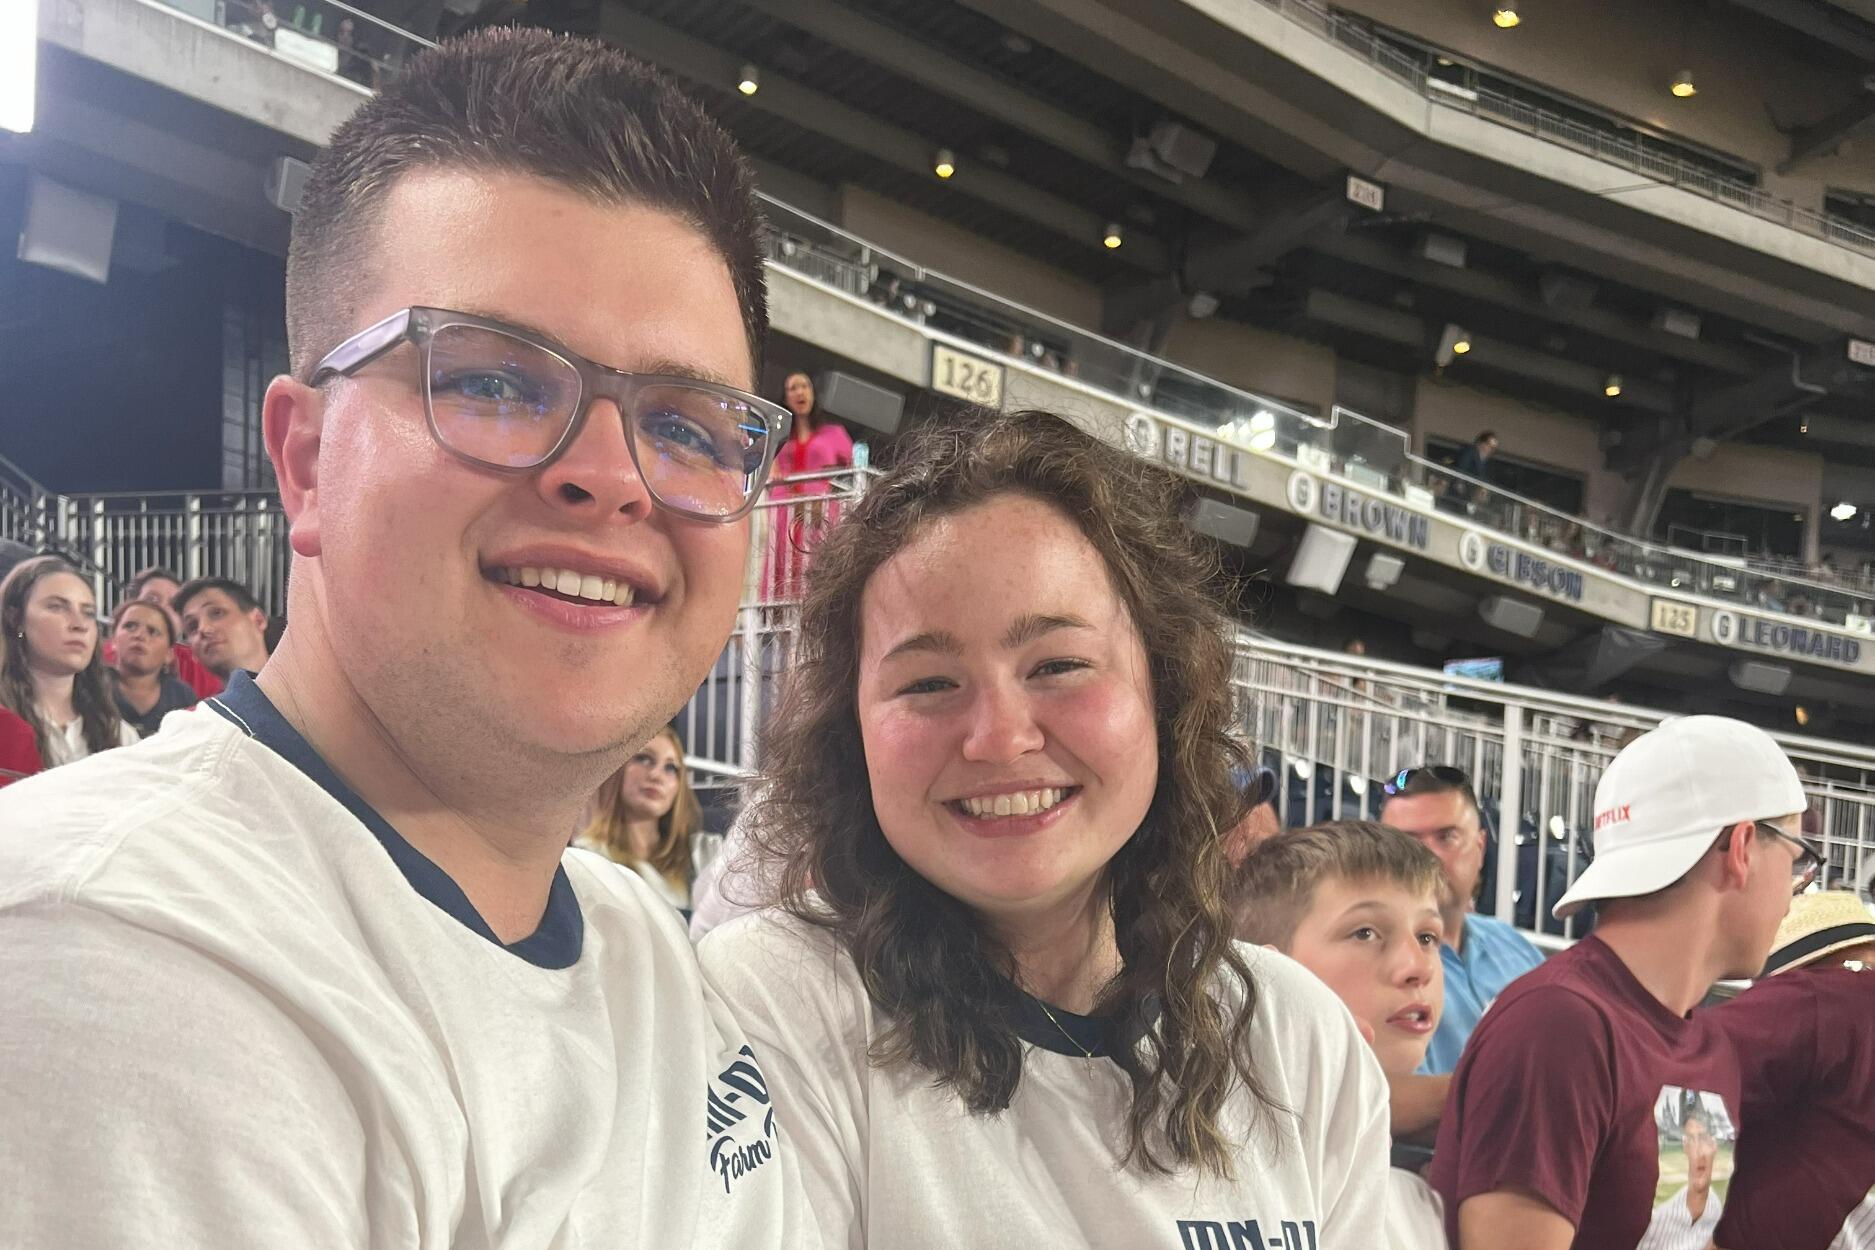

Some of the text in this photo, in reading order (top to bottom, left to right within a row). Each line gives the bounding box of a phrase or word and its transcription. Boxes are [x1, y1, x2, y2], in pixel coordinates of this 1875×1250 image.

[944, 357, 993, 398] 126
[1320, 481, 1429, 549] BROWN
[1486, 543, 1583, 601] GIBSON
[1660, 606, 1690, 632] 125
[1739, 616, 1861, 664] LEONARD
[710, 1135, 771, 1194] Farm
